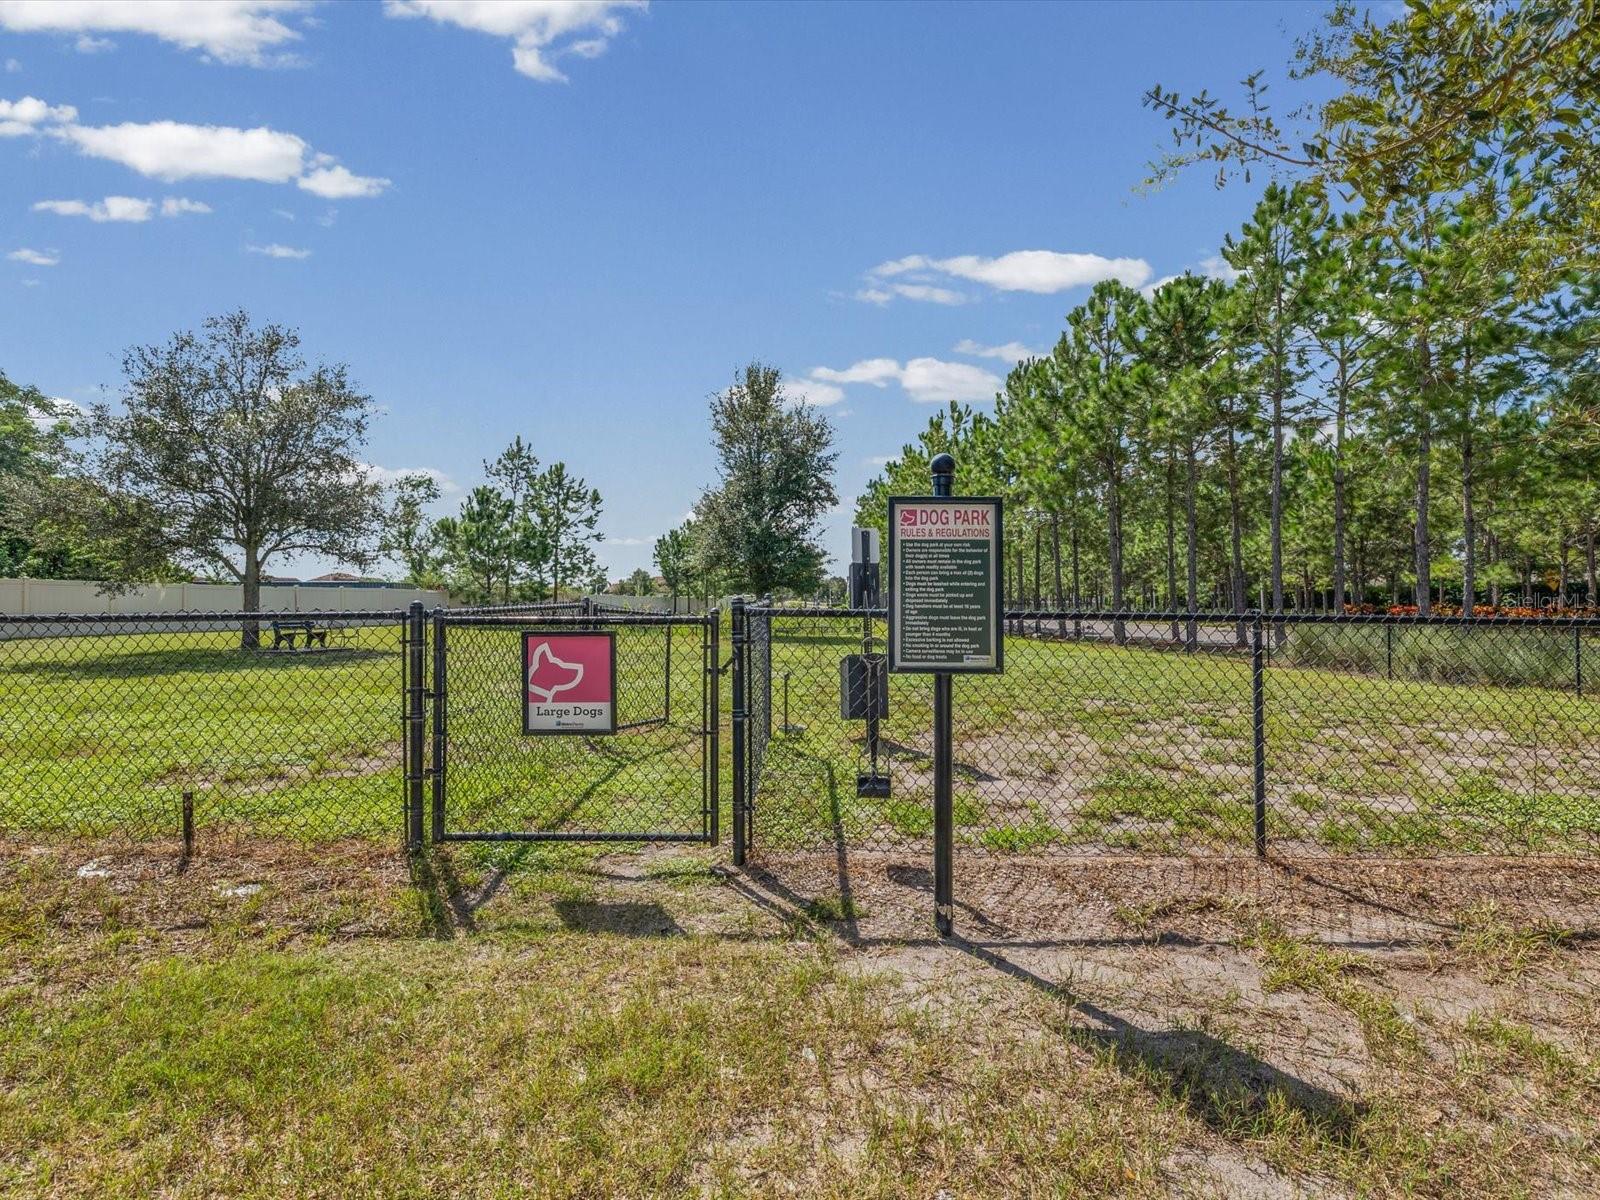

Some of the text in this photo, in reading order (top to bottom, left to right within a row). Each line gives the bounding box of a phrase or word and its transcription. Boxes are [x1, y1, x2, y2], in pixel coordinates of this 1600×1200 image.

[920, 509, 990, 525] DOG PARK
[901, 528, 990, 537] RULES & REGULATIONS
[536, 706, 603, 718] Large Dogs
